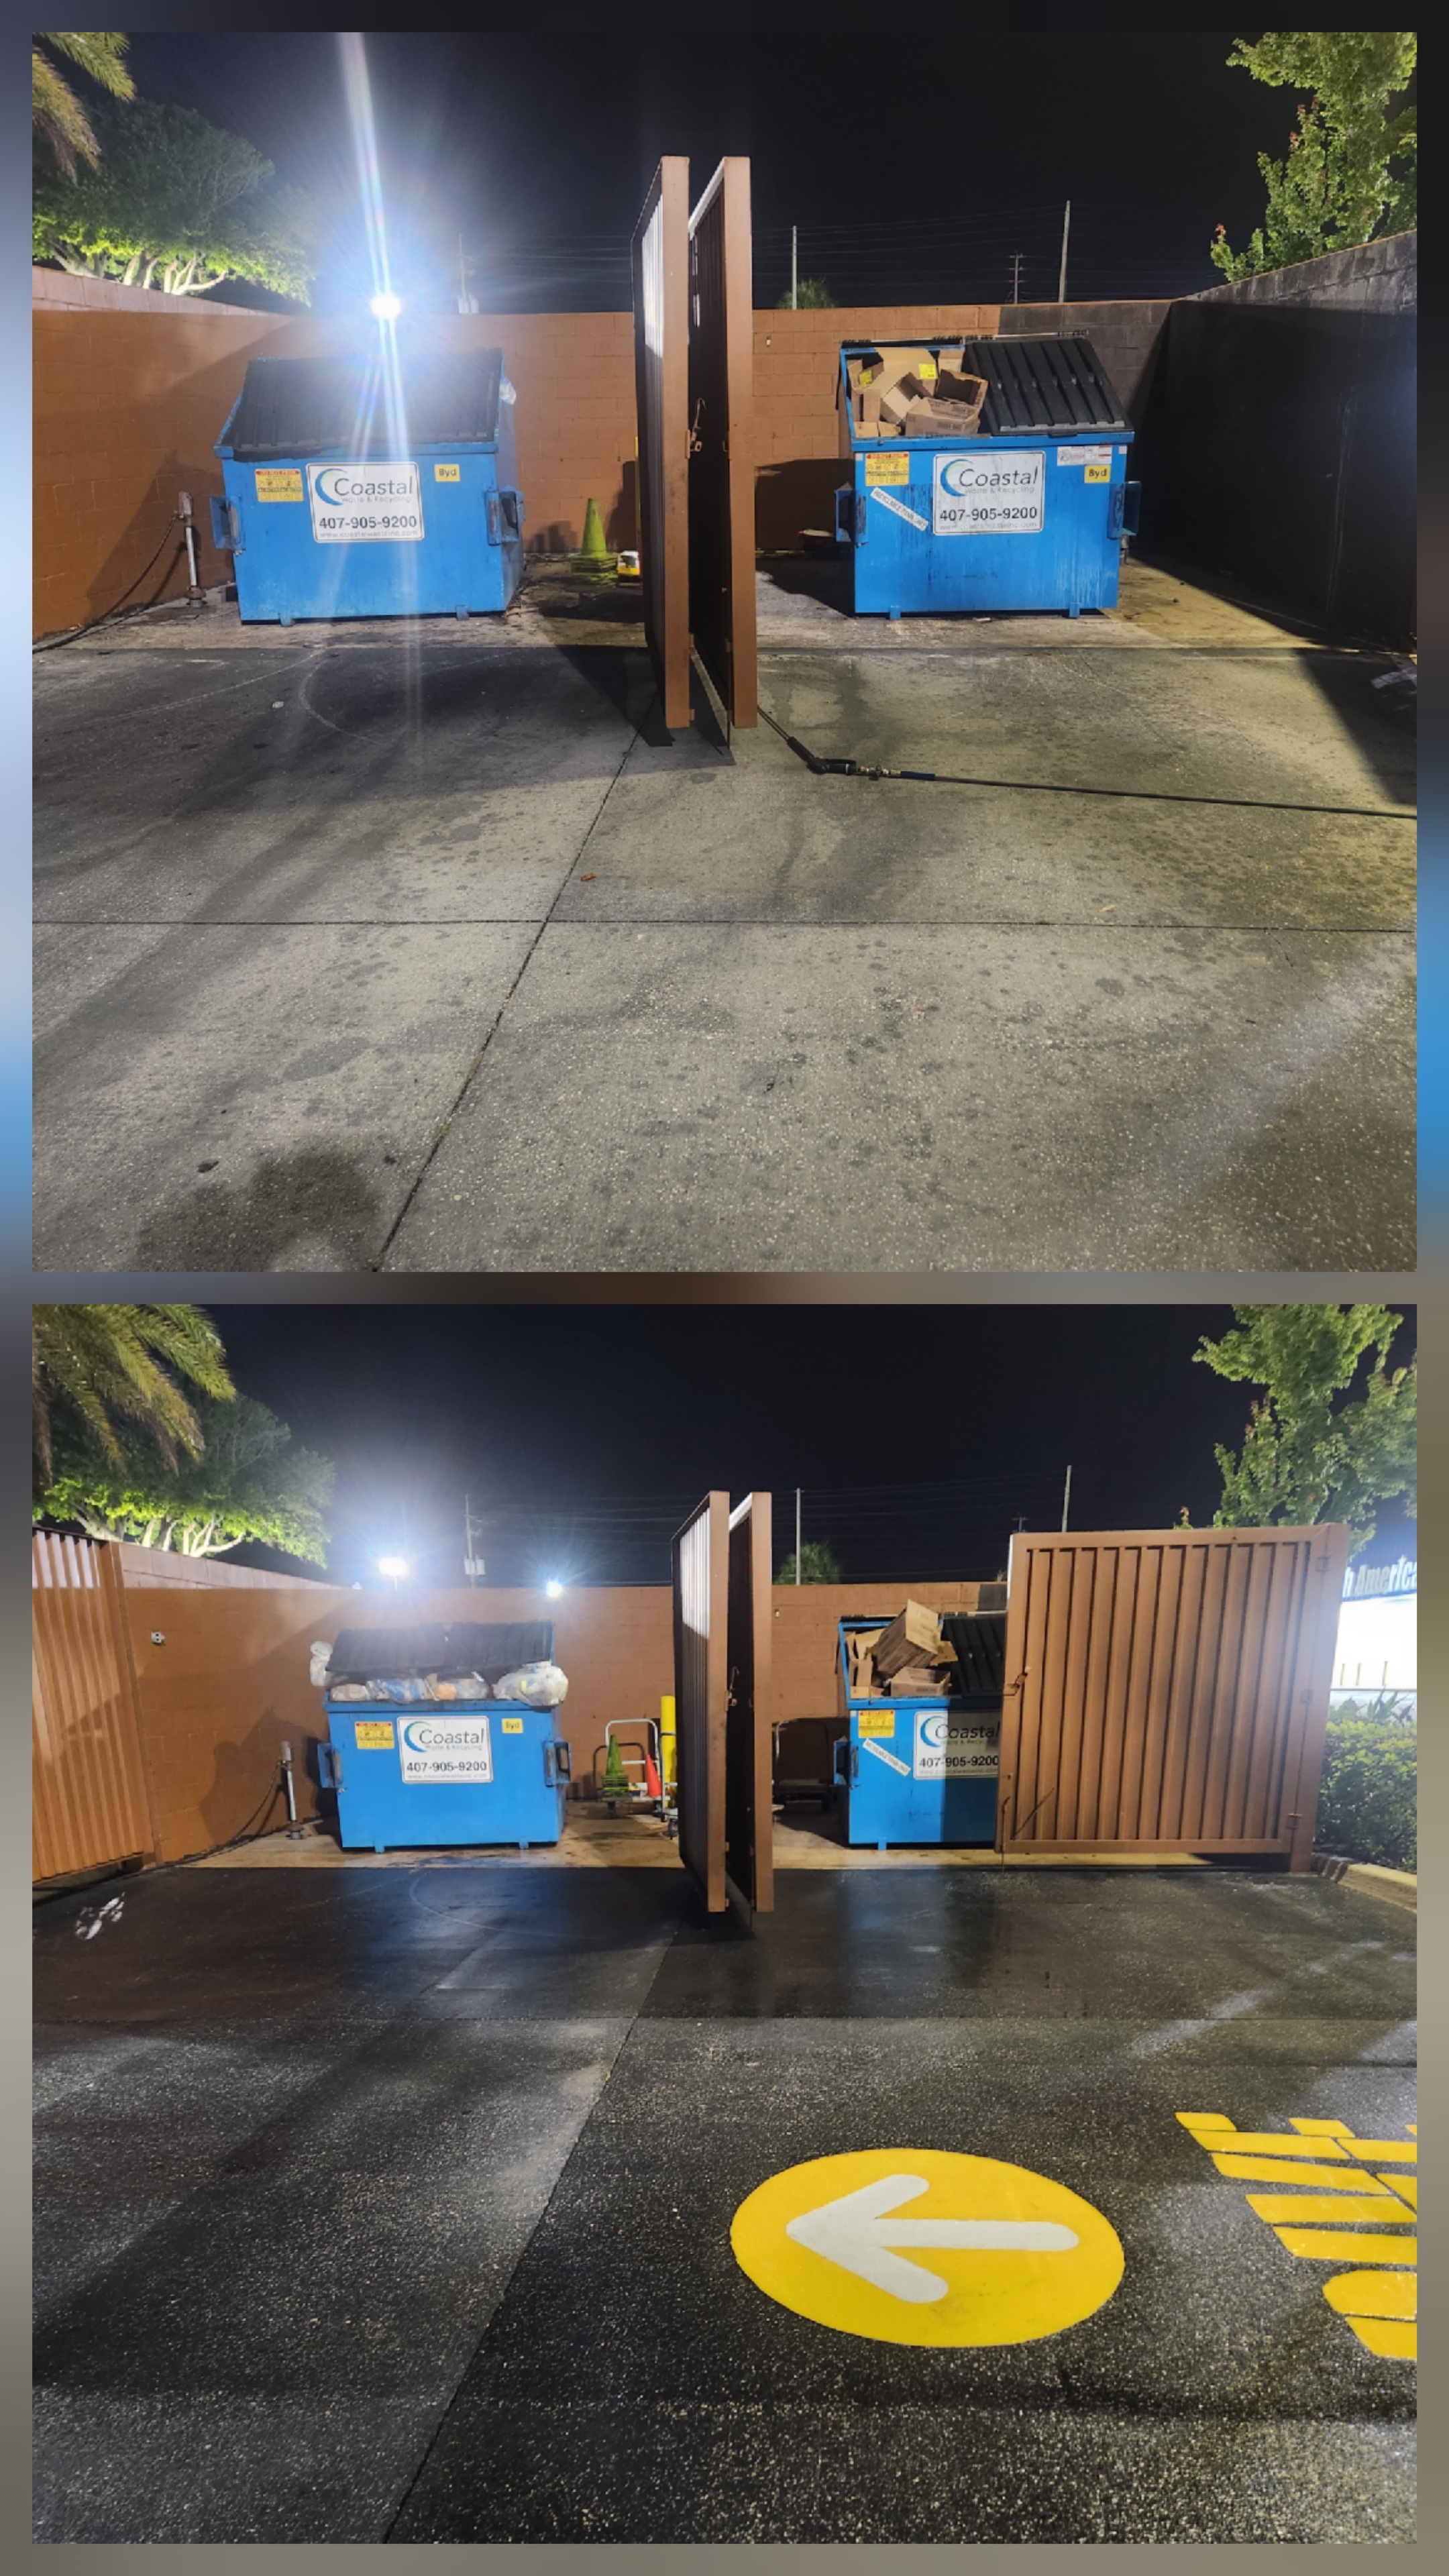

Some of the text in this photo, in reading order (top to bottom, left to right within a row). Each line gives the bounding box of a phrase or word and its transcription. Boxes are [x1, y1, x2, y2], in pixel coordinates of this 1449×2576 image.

[959, 466, 1038, 486] Coastal
[335, 476, 413, 496] Coastal
[998, 486, 1034, 494] Recycling
[374, 496, 411, 504] Recycling
[940, 506, 1037, 521] 407-905-9200
[319, 516, 417, 529] 407-905-9200
[419, 1728, 484, 1744] Coastal
[935, 1721, 1000, 1739] Coastal
[407, 1761, 487, 1772] 407-905-9200
[919, 1755, 999, 1768] 407-905-9200
